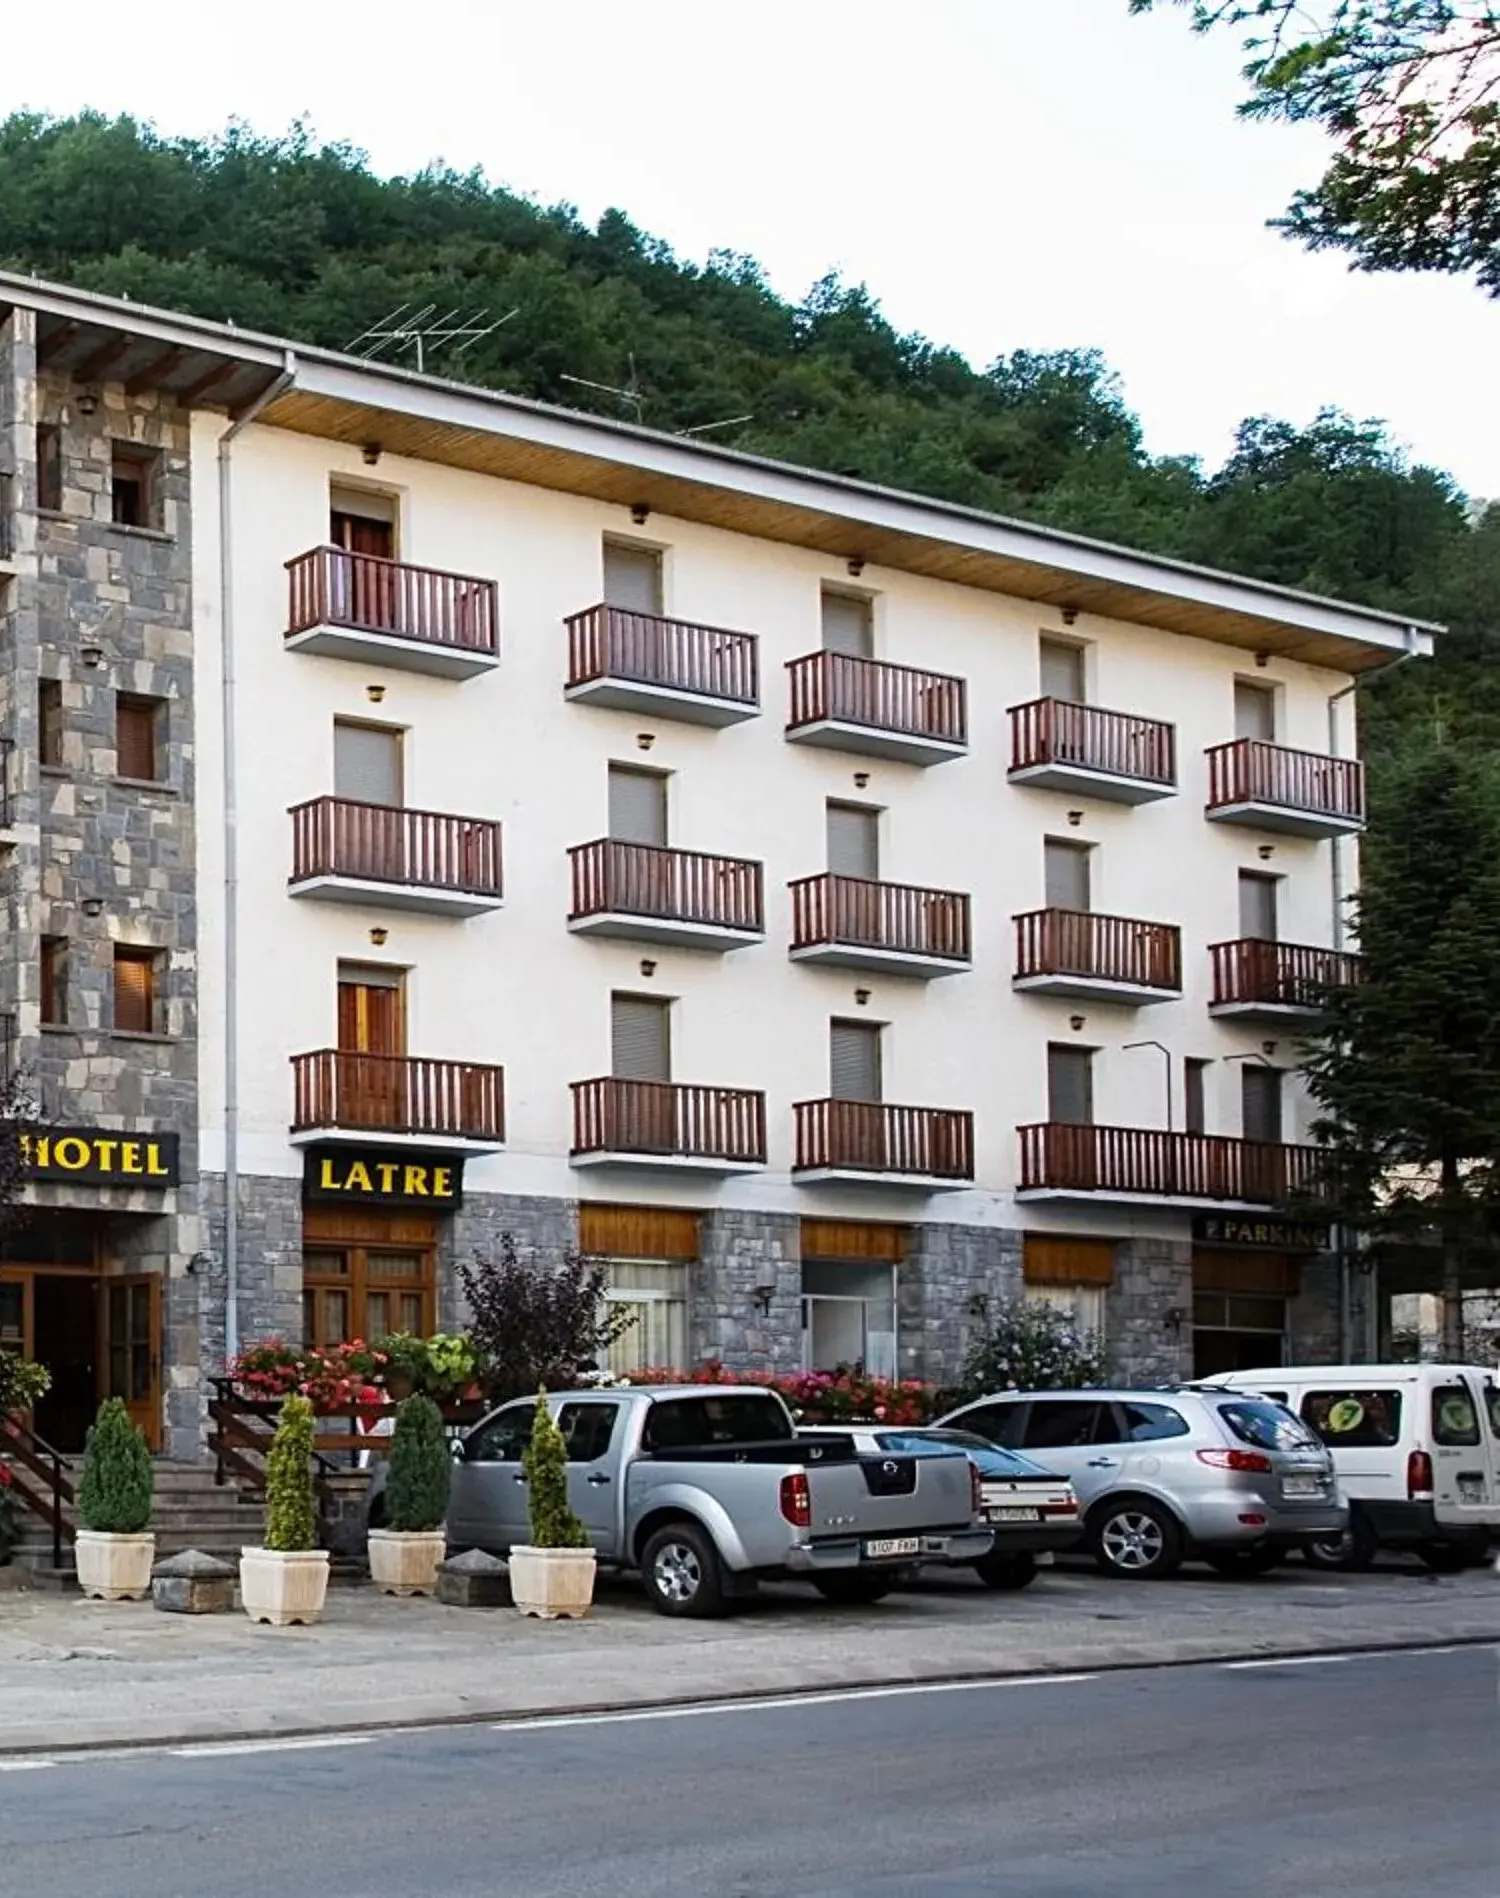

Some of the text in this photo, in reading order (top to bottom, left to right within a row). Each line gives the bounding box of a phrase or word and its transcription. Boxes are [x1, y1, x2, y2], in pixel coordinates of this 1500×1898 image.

[19, 1135, 169, 1175] HOTEL
[321, 1159, 453, 1197] LATRE
[1224, 1220, 1327, 1247] PARKING
